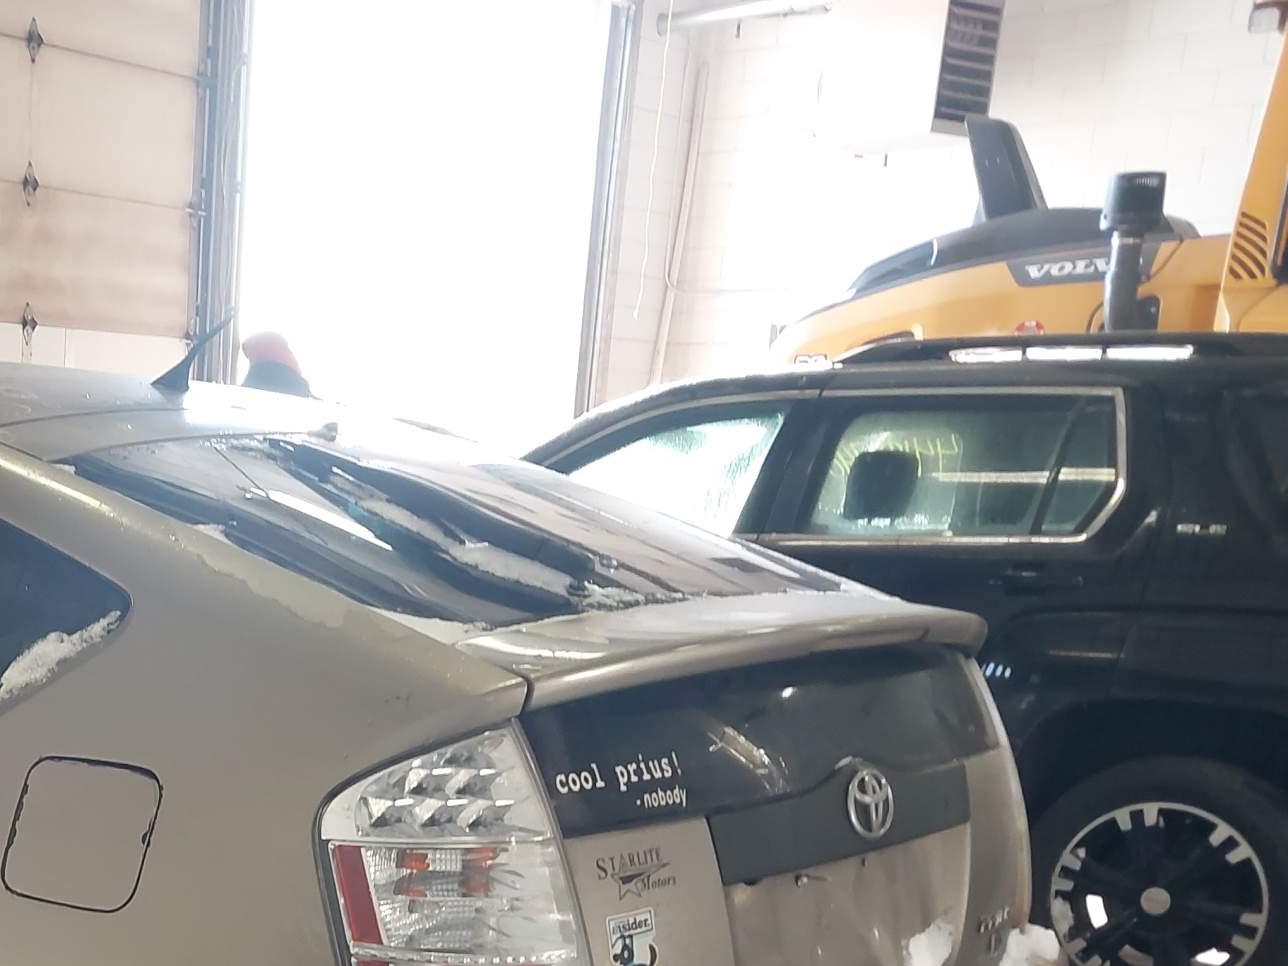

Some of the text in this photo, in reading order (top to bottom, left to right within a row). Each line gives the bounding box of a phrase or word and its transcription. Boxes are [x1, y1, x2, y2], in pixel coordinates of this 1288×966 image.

[1024, 256, 1110, 280] VOLV
[555, 750, 682, 794] cool prius!
[595, 847, 662, 881] STARLITE
[636, 872, 679, 891] Motors
